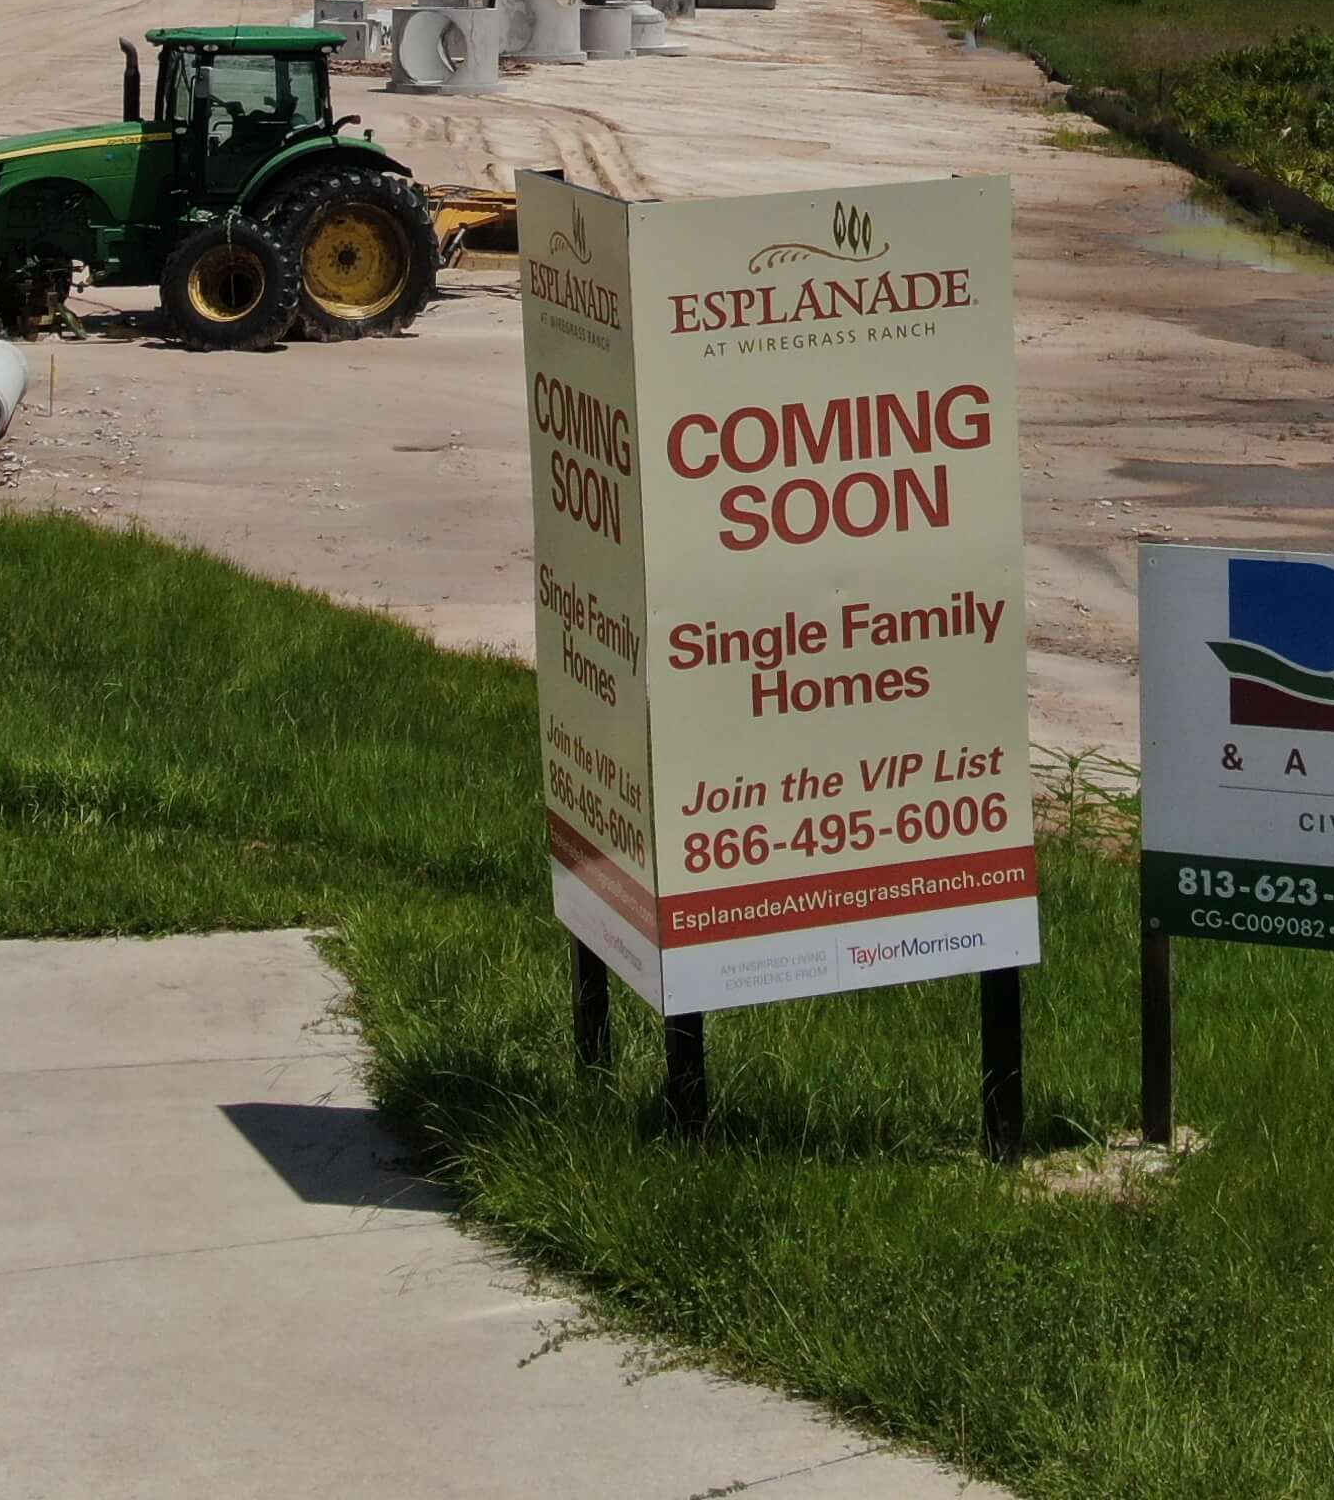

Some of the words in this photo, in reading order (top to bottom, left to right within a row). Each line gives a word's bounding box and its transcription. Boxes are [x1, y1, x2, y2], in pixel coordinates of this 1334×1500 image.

[529, 259, 620, 330] ESPLANADE
[668, 268, 971, 334] ESPLANADE
[704, 341, 727, 358] AT
[738, 329, 857, 356] WIREGRASS
[868, 322, 937, 341] RANCH
[534, 371, 631, 476] COMING
[667, 384, 992, 479] COMING
[551, 449, 621, 545] SOON
[719, 465, 950, 552] SOON
[539, 563, 584, 632] Single
[587, 592, 640, 676] Family
[668, 611, 827, 671] Single
[841, 590, 1006, 650] Family
[563, 630, 617, 708] Homes
[751, 664, 931, 717] Homes
[547, 715, 571, 758] Join
[573, 735, 593, 775] the
[595, 748, 616, 790] VIP
[619, 767, 642, 813] List
[682, 776, 767, 817] Join
[781, 767, 844, 804] the
[859, 752, 923, 793] VIP
[934, 746, 1005, 784] List
[1221, 743, 1244, 771] &
[549, 758, 645, 869] 866-495-6006
[683, 792, 1009, 874] 866-495-6006
[672, 866, 1026, 931] EsplanadeAtWiregrassRanch.com
[725, 971, 793, 991] EXPERIENCE
[795, 965, 828, 981] FROM
[738, 957, 789, 975] INSPIRED
[792, 951, 828, 966] LIVING
[847, 932, 984, 967] TaylorMorrison
